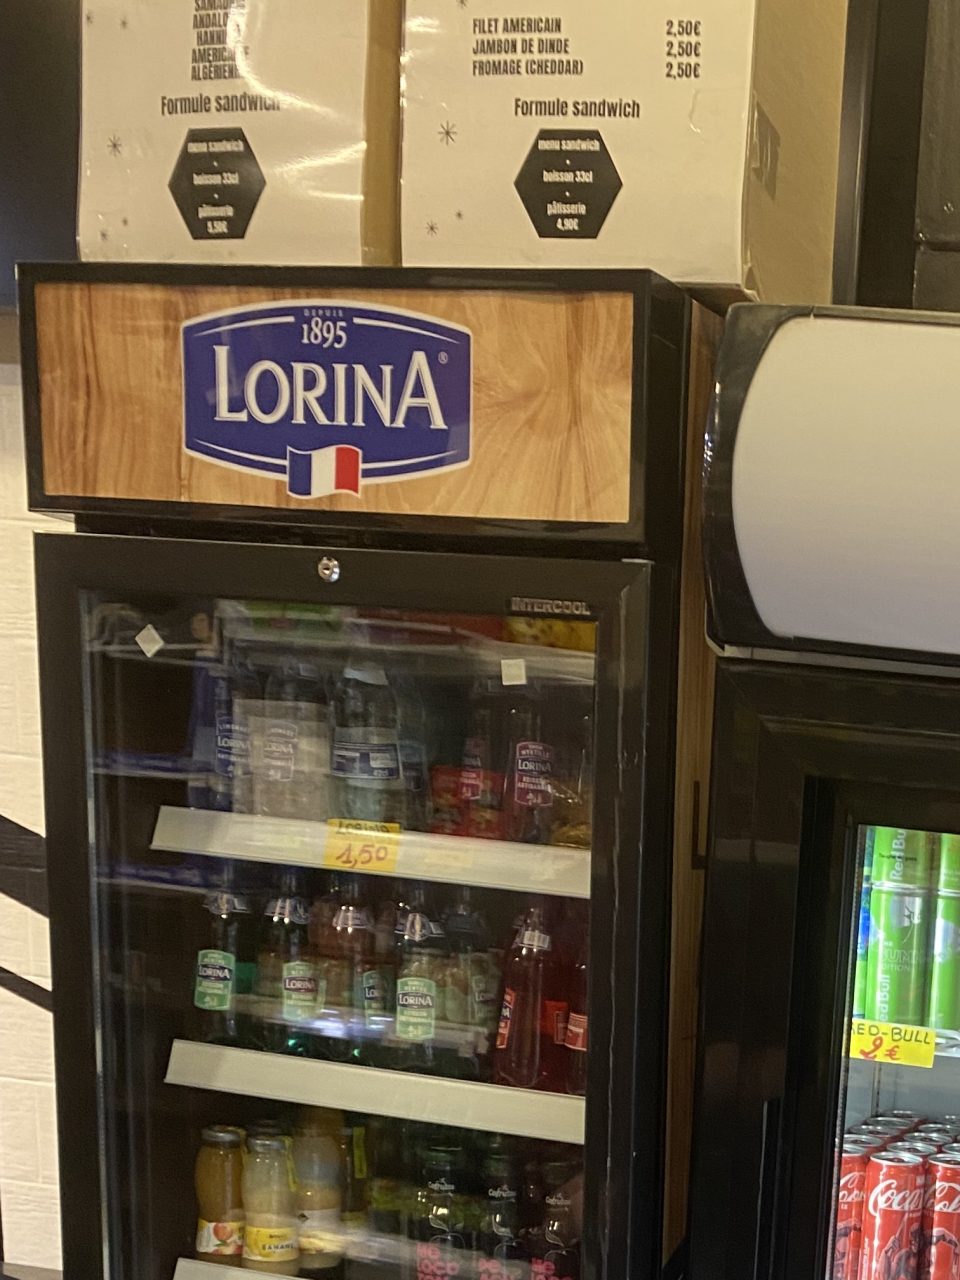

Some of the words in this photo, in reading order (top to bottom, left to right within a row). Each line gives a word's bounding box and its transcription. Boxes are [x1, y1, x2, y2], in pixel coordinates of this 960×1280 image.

[192, 11, 242, 30] ANDALO
[472, 18, 499, 34] FILET
[502, 17, 562, 34] AMERICAIN
[666, 20, 701, 37] 2,50€
[472, 38, 517, 55] JAMBON
[521, 38, 534, 54] DE
[537, 38, 570, 54] DINDE
[666, 41, 701, 58] 2,50€
[472, 59, 522, 76] FROMAGE
[525, 58, 584, 76] (CHEDDAR)
[666, 62, 701, 79] 2,50€
[161, 93, 211, 116] Formule
[215, 92, 281, 113] sandwich
[514, 98, 568, 117] Formule
[572, 97, 641, 119] sandwich
[561, 139, 600, 152] sandwich
[543, 170, 574, 183] boisson
[575, 170, 593, 183] 33cl
[301, 316, 348, 349] 1895
[212, 344, 449, 431] LORINA
[511, 597, 591, 616] INTERCOOL
[336, 843, 389, 869] 1,50
[199, 964, 231, 980] LORINA
[399, 993, 433, 1007] LORINA
